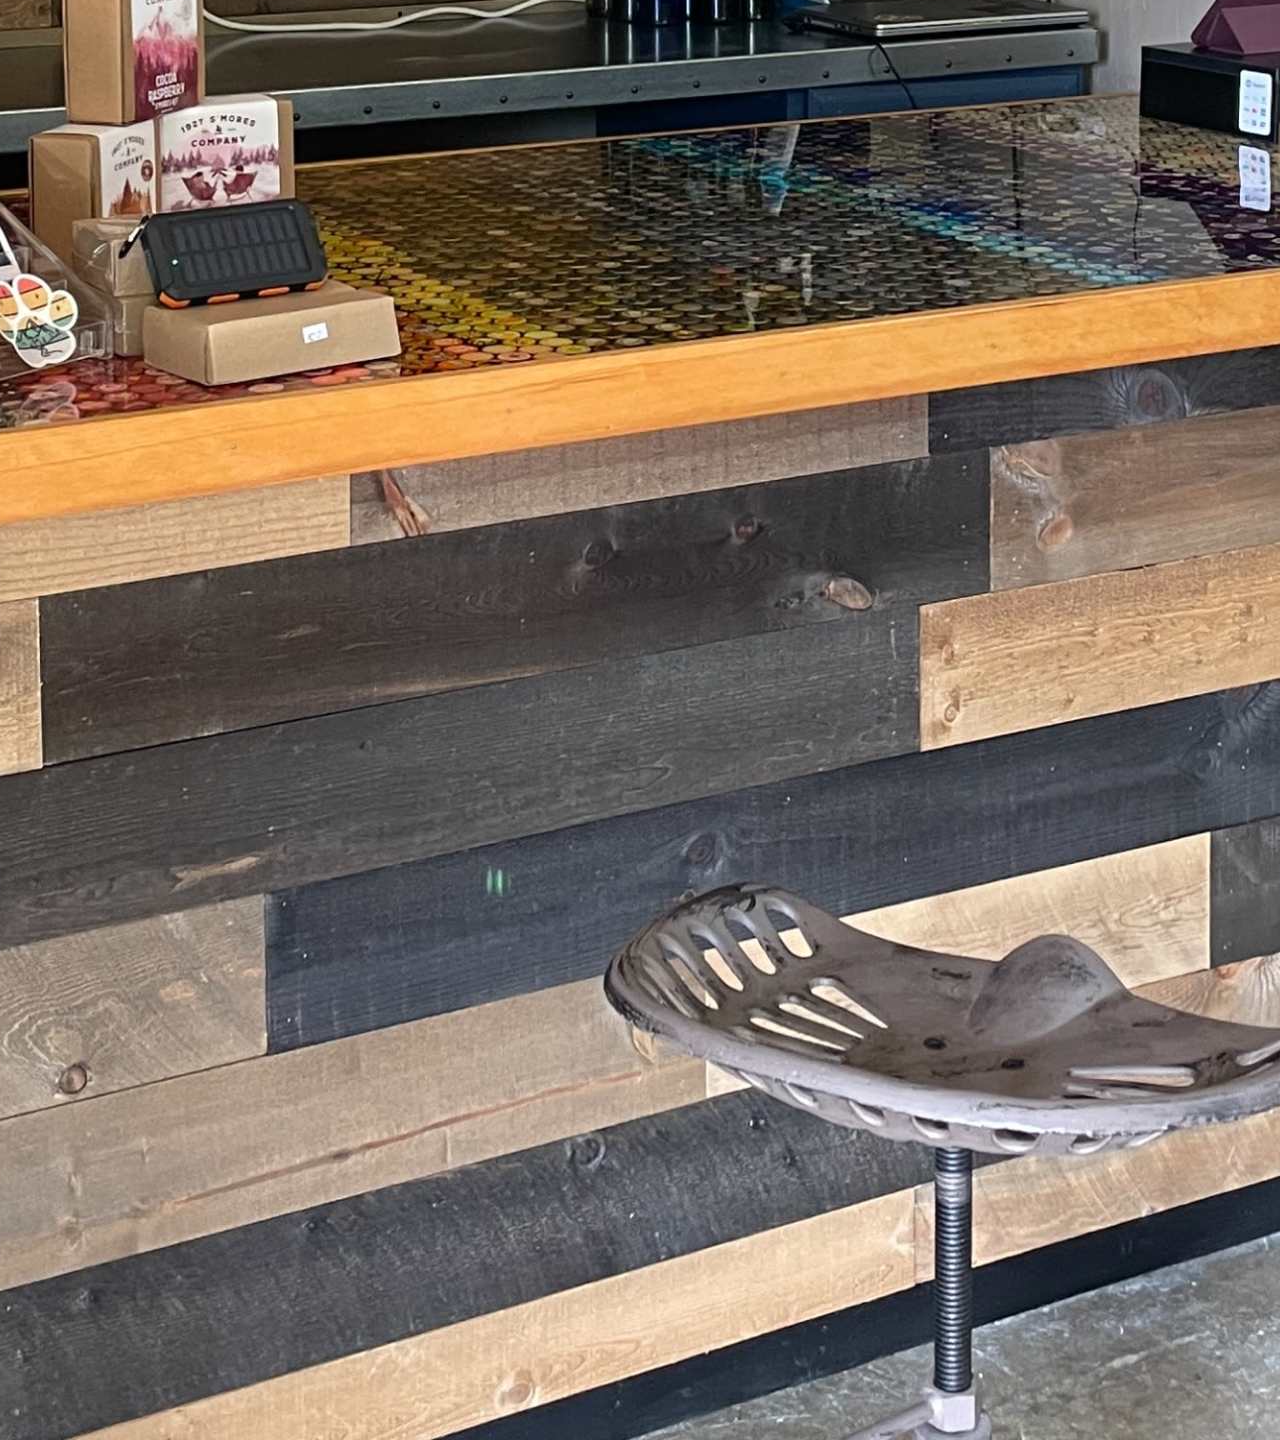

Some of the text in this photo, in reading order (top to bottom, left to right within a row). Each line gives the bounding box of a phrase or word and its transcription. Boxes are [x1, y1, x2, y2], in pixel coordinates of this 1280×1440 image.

[155, 72, 177, 87] COCOA
[148, 83, 185, 102] RASPBERRY
[190, 135, 246, 148] COMPANY
[113, 155, 144, 171] COMPANY
